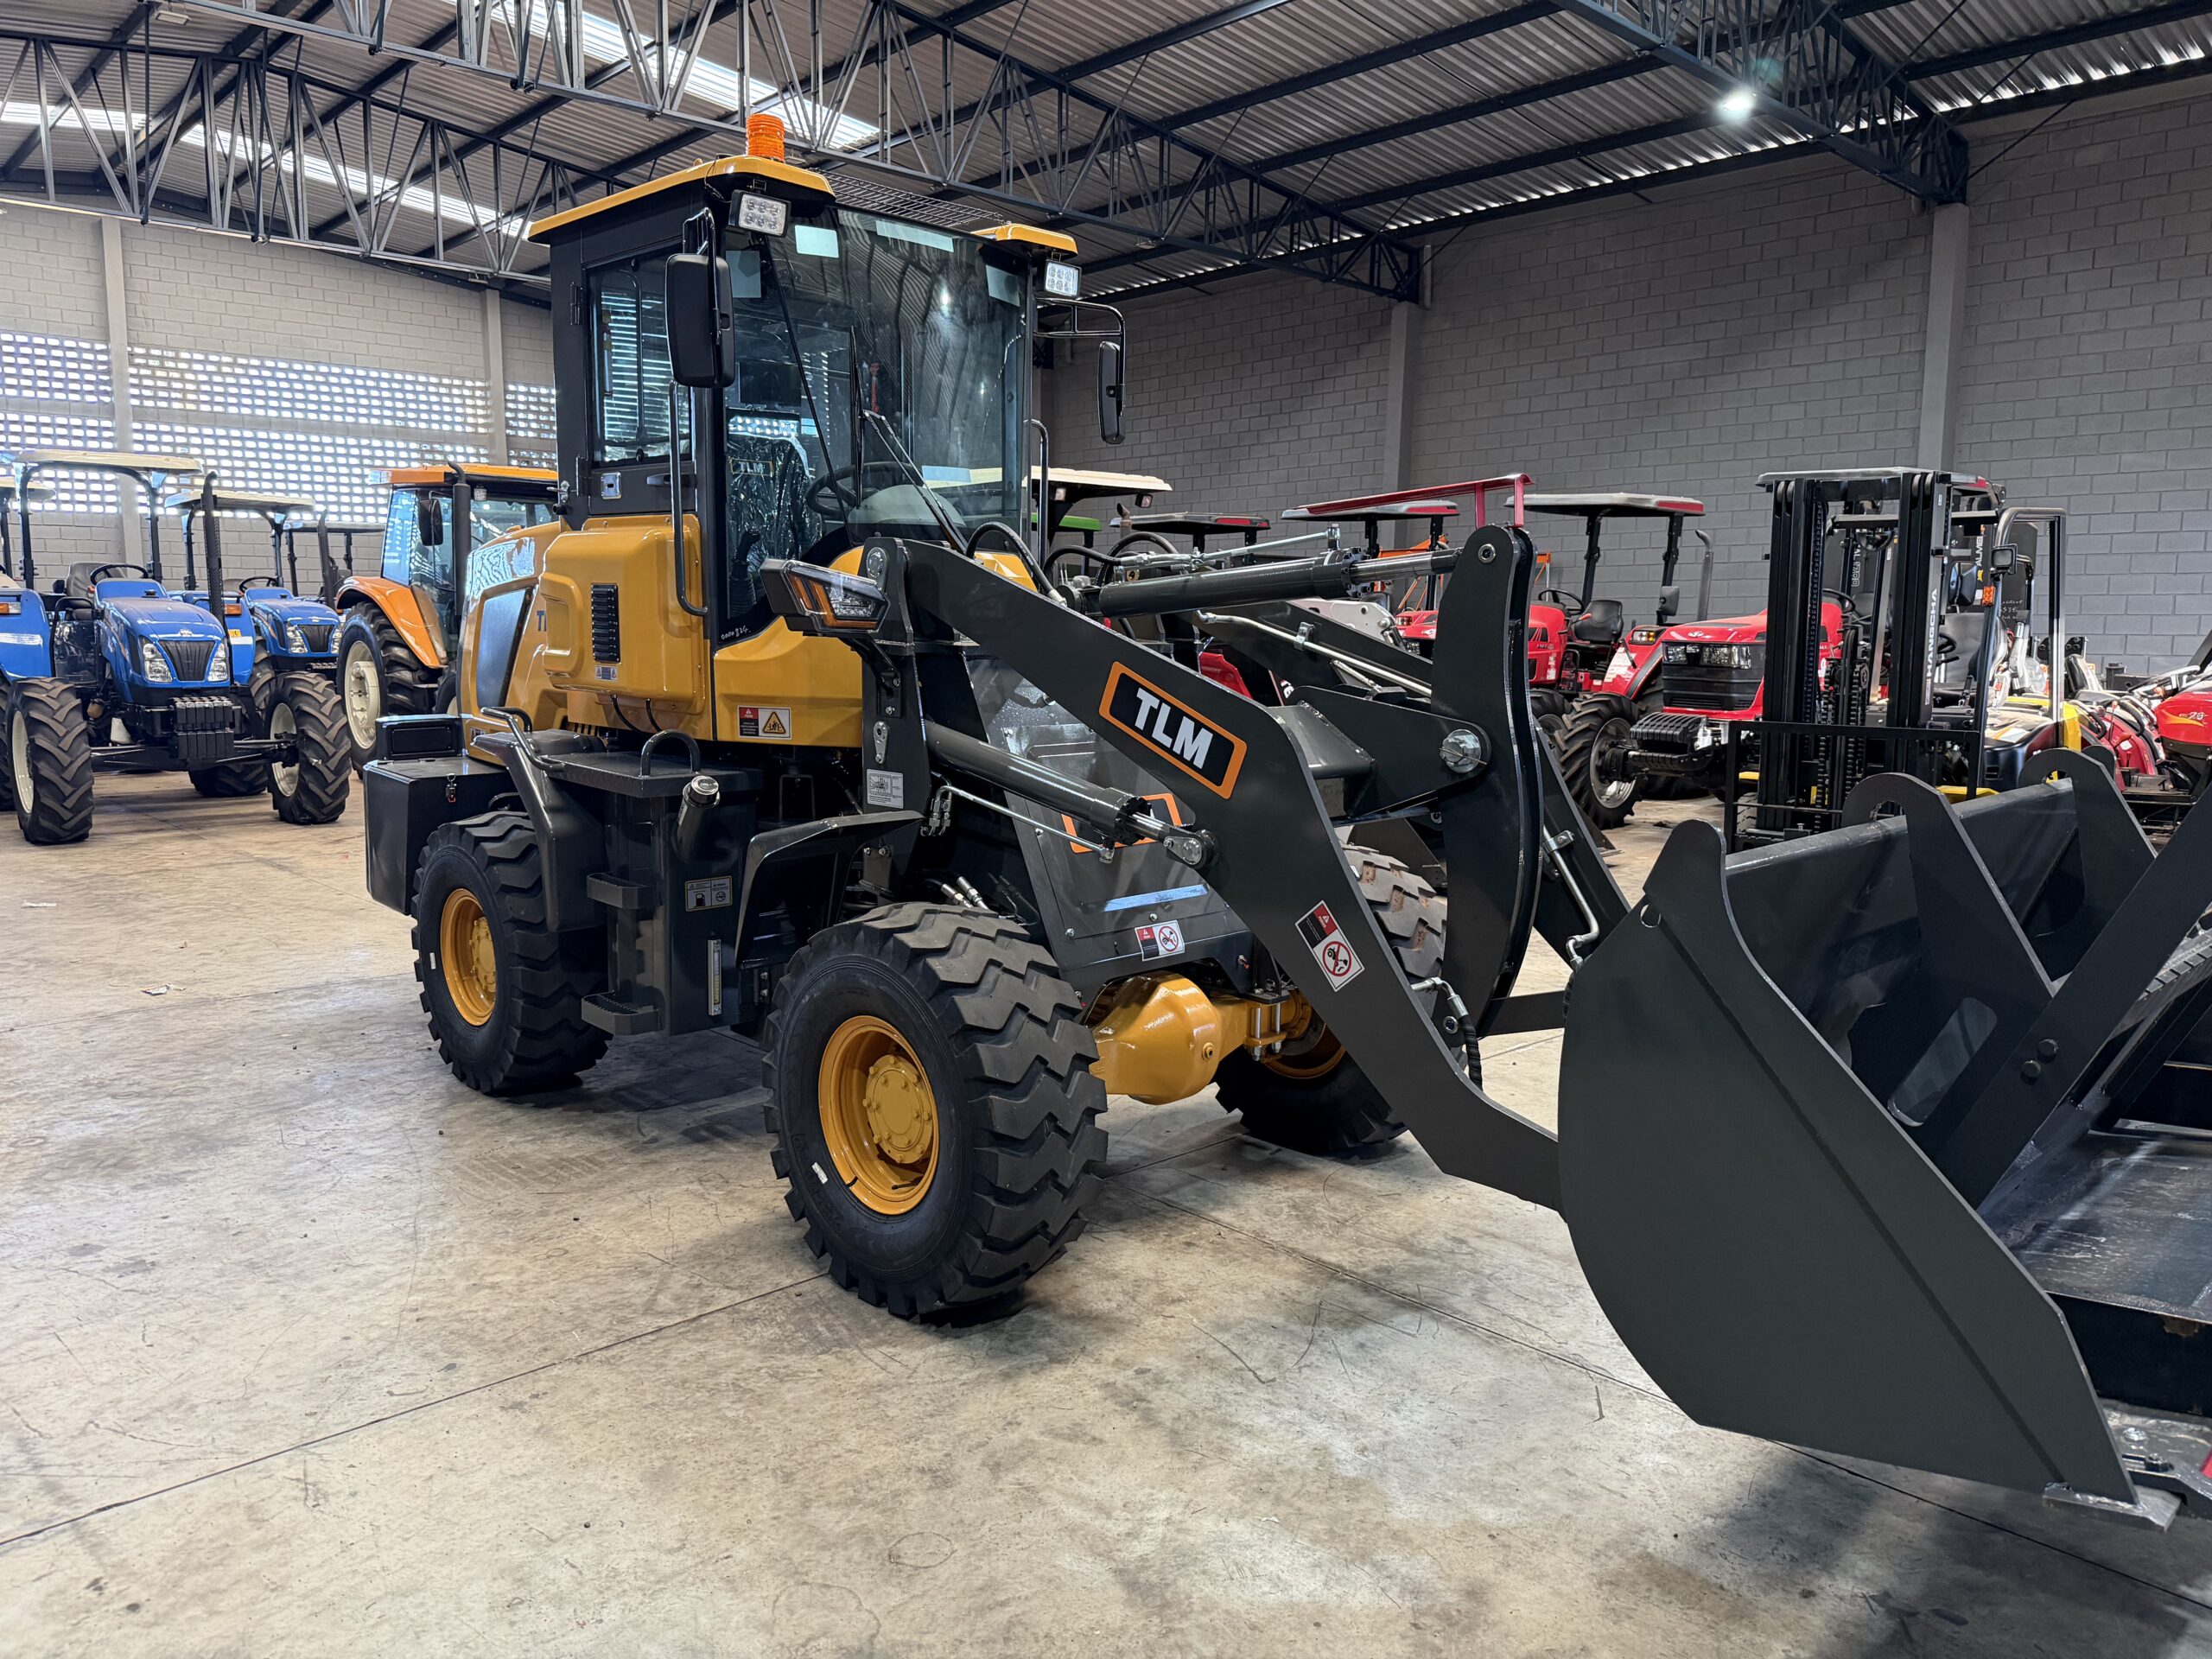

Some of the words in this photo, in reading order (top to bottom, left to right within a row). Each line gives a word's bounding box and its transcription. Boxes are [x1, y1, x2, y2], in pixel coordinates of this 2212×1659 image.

[738, 461, 764, 474] TLM
[1926, 588, 1937, 677] HANGCHA
[1135, 687, 1214, 770] TLM
